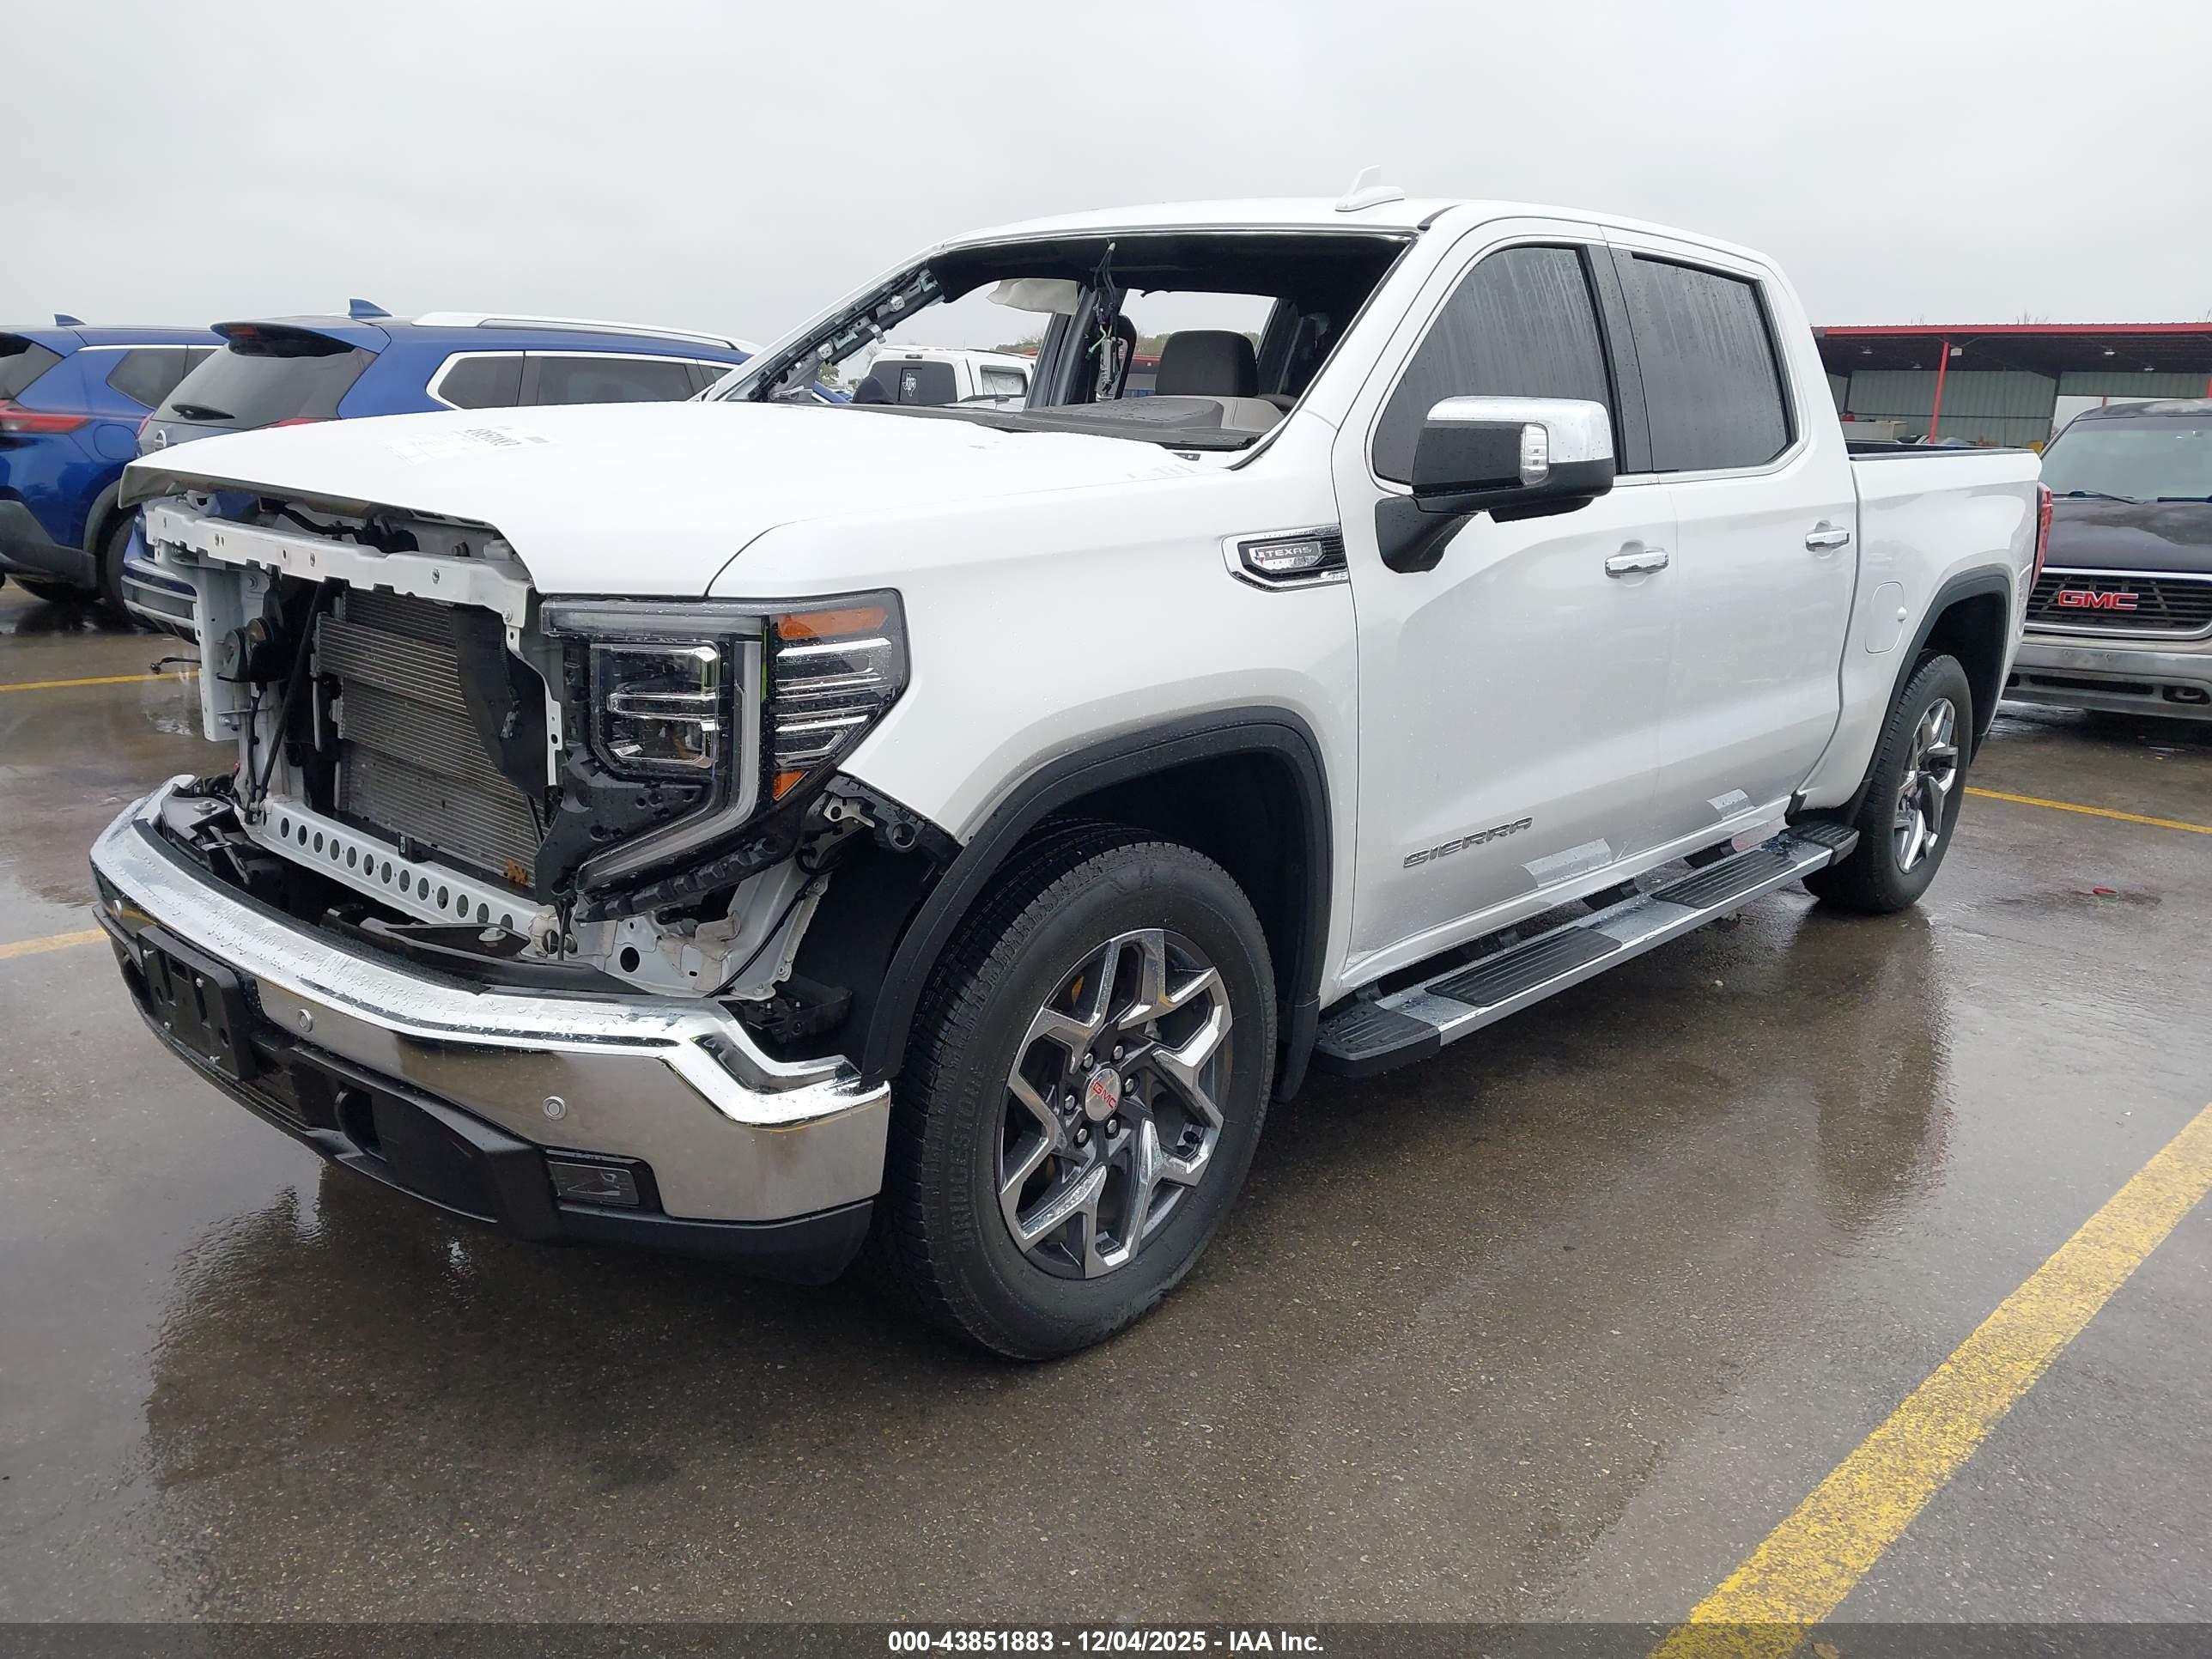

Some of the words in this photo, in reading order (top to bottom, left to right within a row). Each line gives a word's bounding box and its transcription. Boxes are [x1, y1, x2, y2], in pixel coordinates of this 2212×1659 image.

[1265, 546, 1312, 558] TEXAS
[2058, 589, 2139, 611] GMC
[1403, 816, 1533, 868] SIERRA
[1092, 1081, 1117, 1109] GMC
